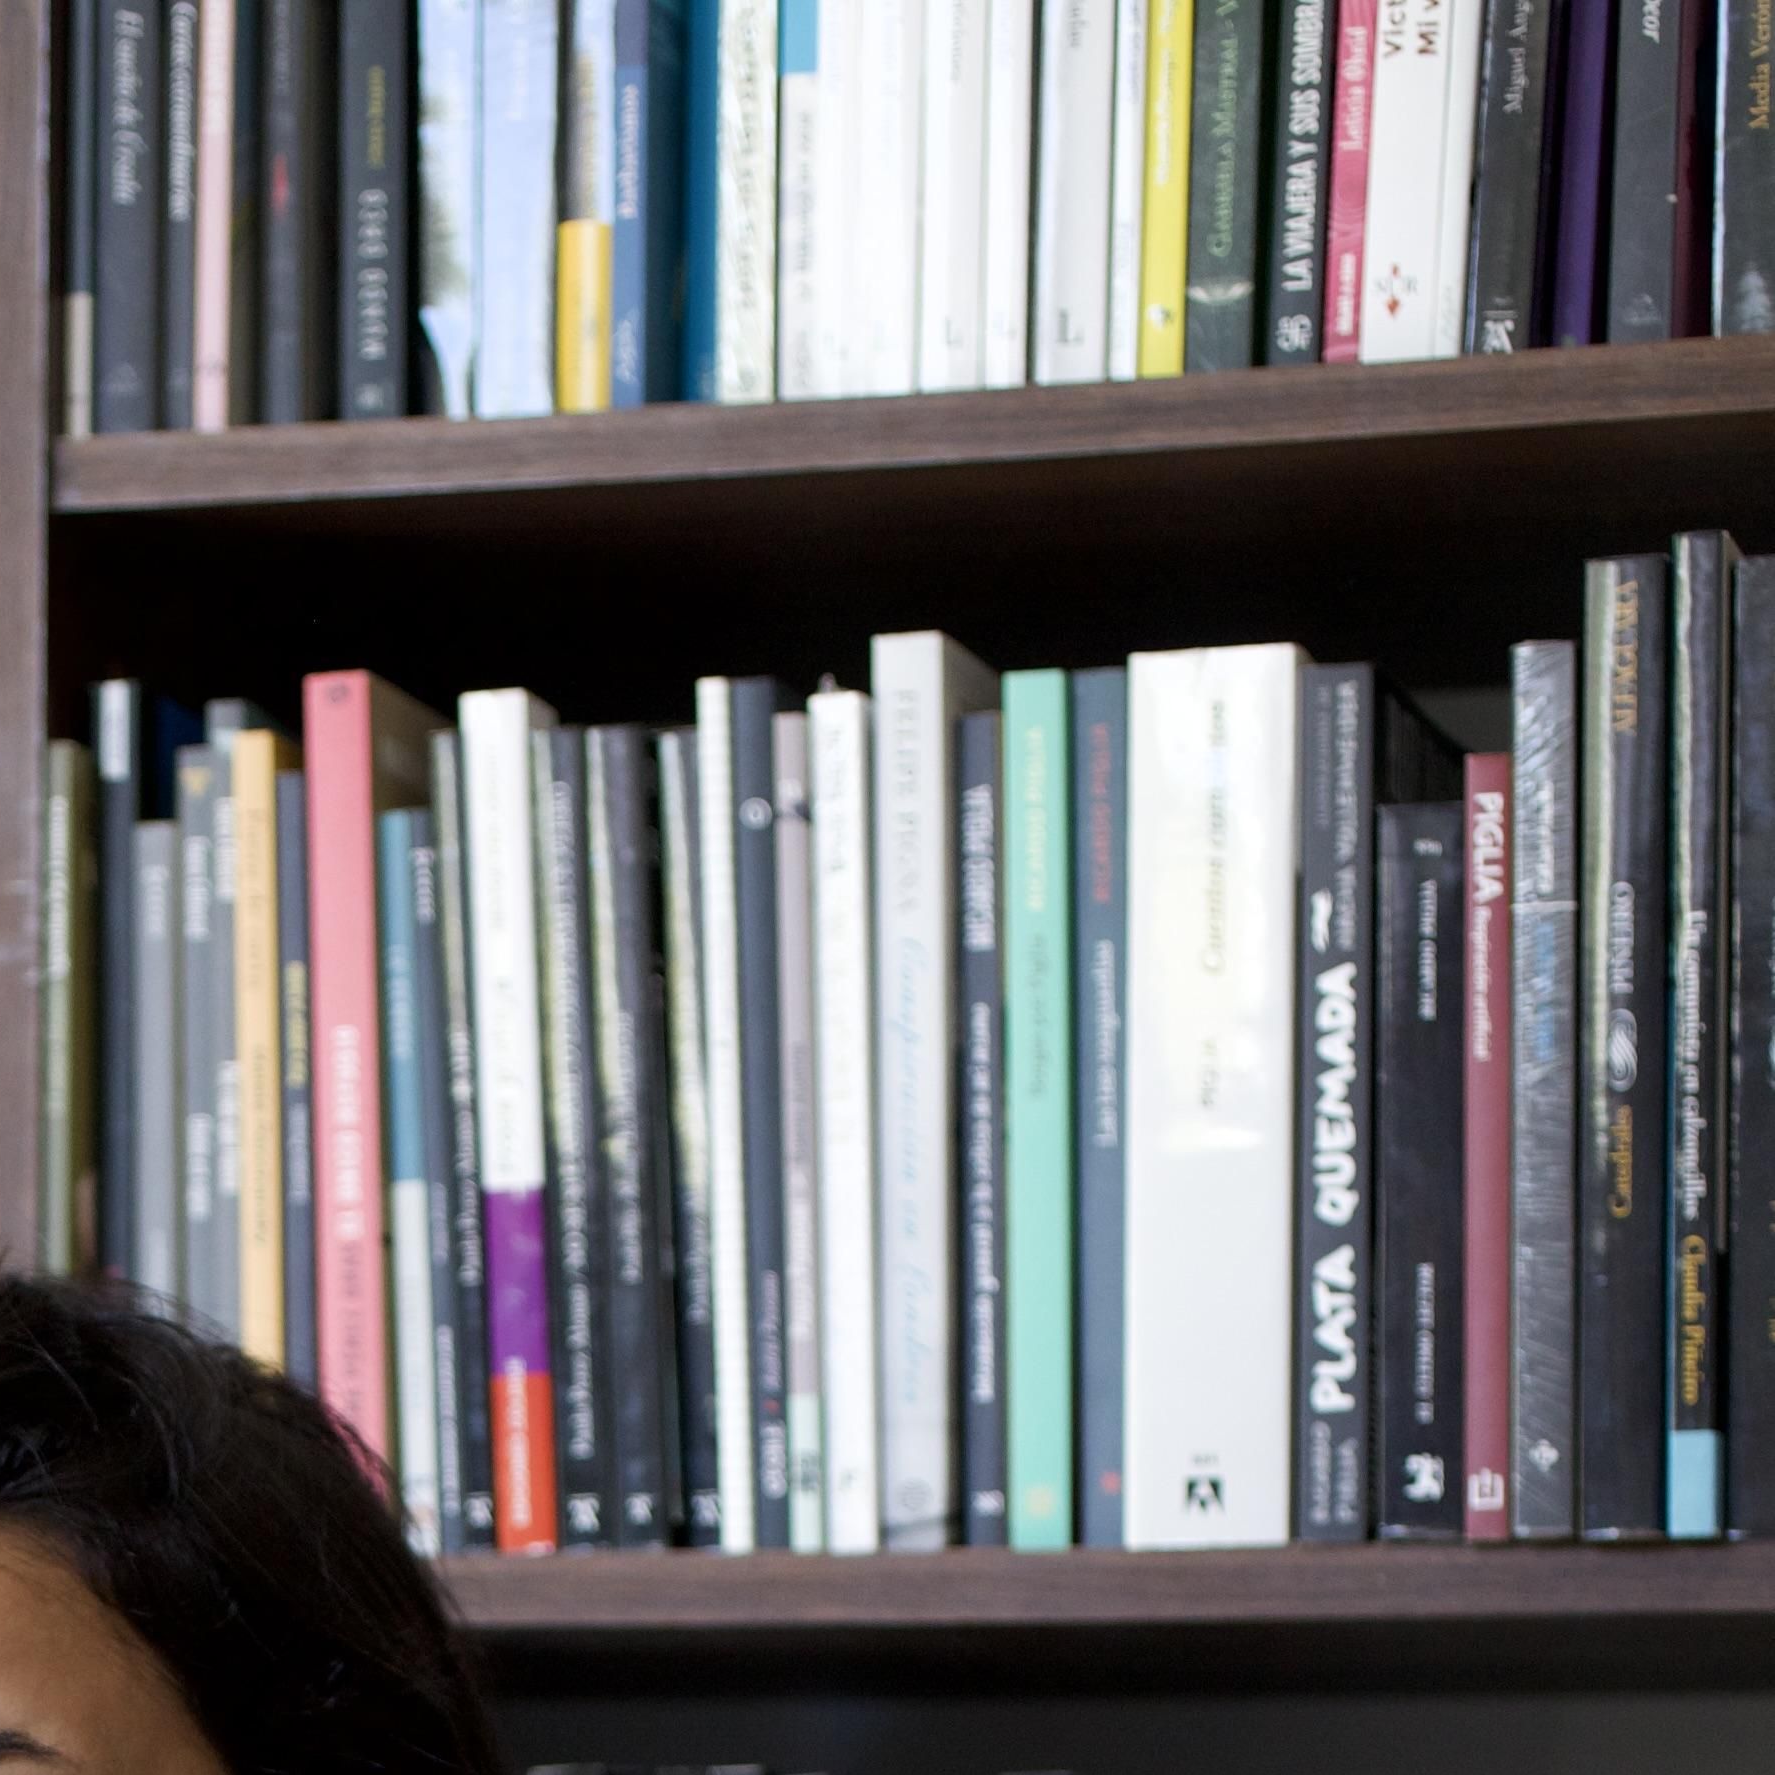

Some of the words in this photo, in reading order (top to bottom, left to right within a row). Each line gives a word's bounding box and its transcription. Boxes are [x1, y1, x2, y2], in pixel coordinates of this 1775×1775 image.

[1287, 140, 1317, 158] Y
[1288, 89, 1321, 136] SUS
[1283, 160, 1318, 258] VIAJERA
[1281, 259, 1314, 291] LA
[963, 784, 995, 854] PIGLIA
[1473, 792, 1505, 904] PIGLIA
[963, 859, 997, 951] RICARDO
[1314, 961, 1359, 1226] QUEMADA
[1310, 1244, 1357, 1414] PLATA
